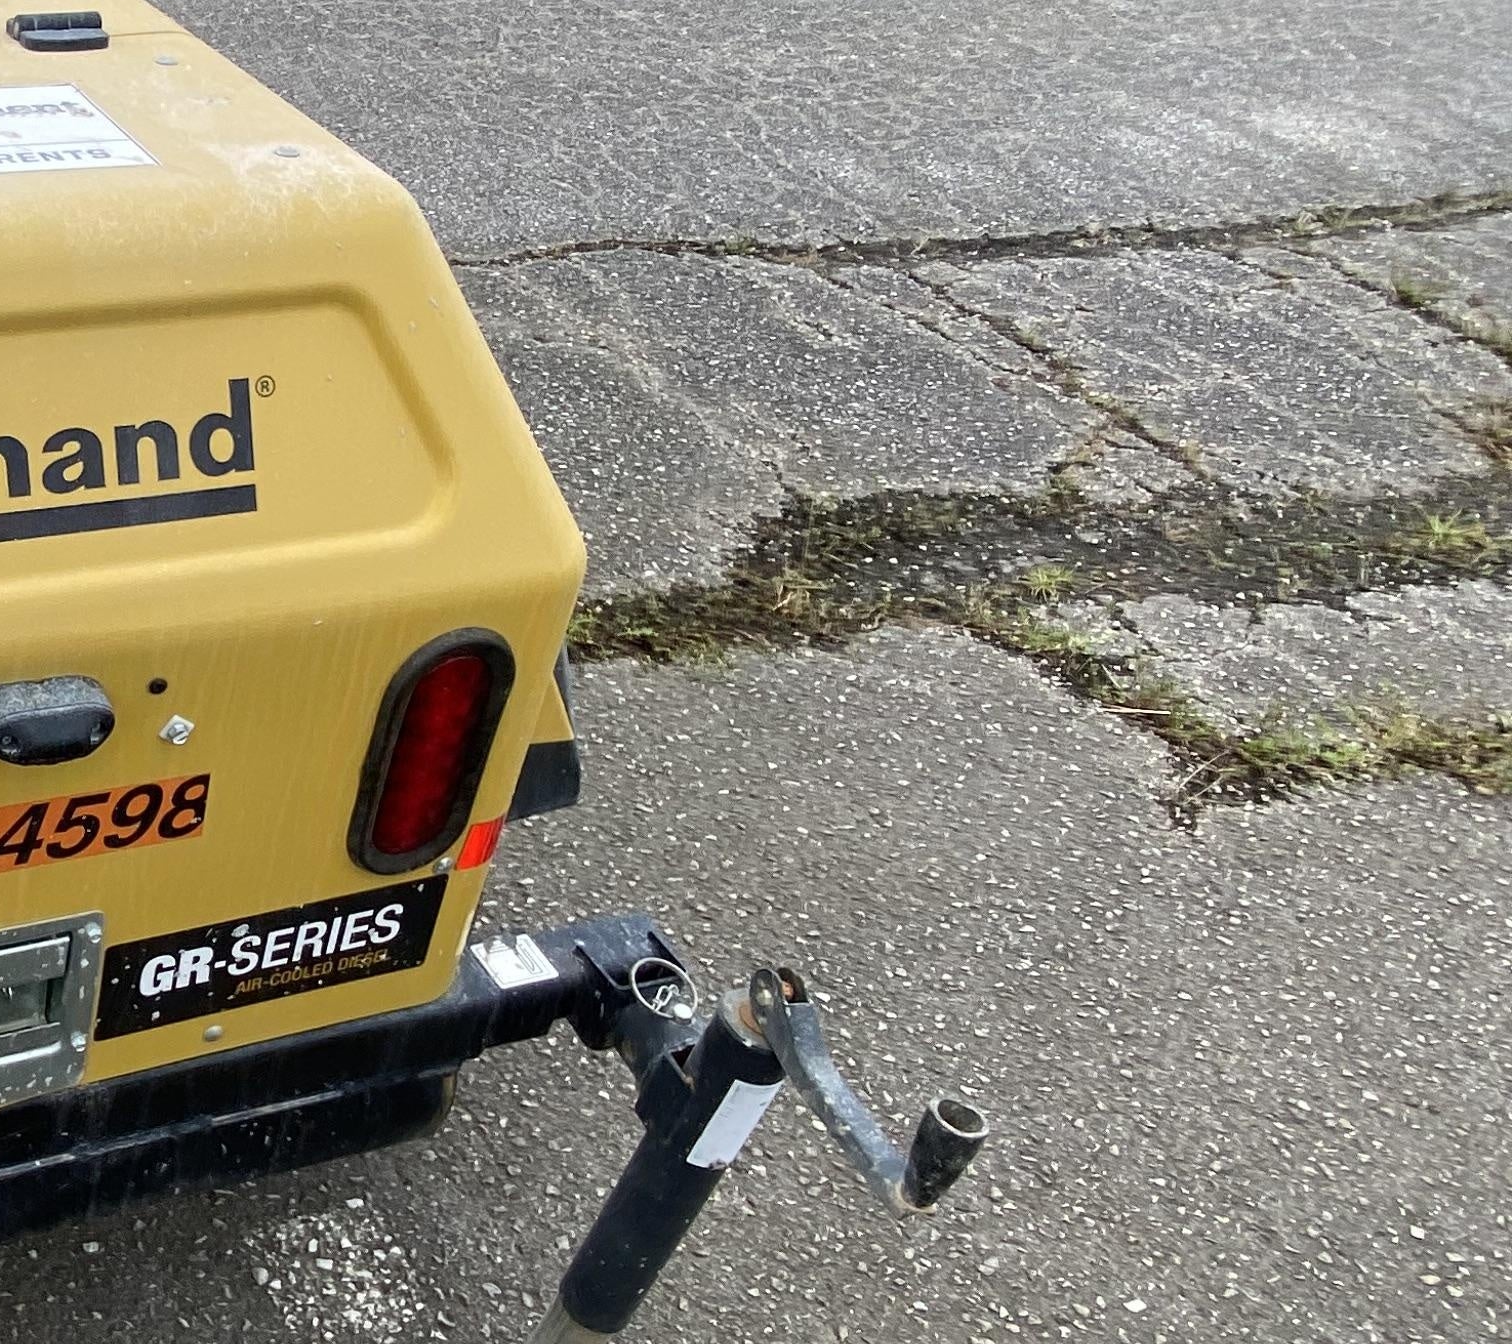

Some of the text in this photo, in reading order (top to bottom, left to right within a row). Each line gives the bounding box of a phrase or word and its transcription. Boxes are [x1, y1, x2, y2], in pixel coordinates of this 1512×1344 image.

[139, 903, 404, 997] GR-SERIES
[235, 948, 392, 995] AIR-COOLED DIESEL
